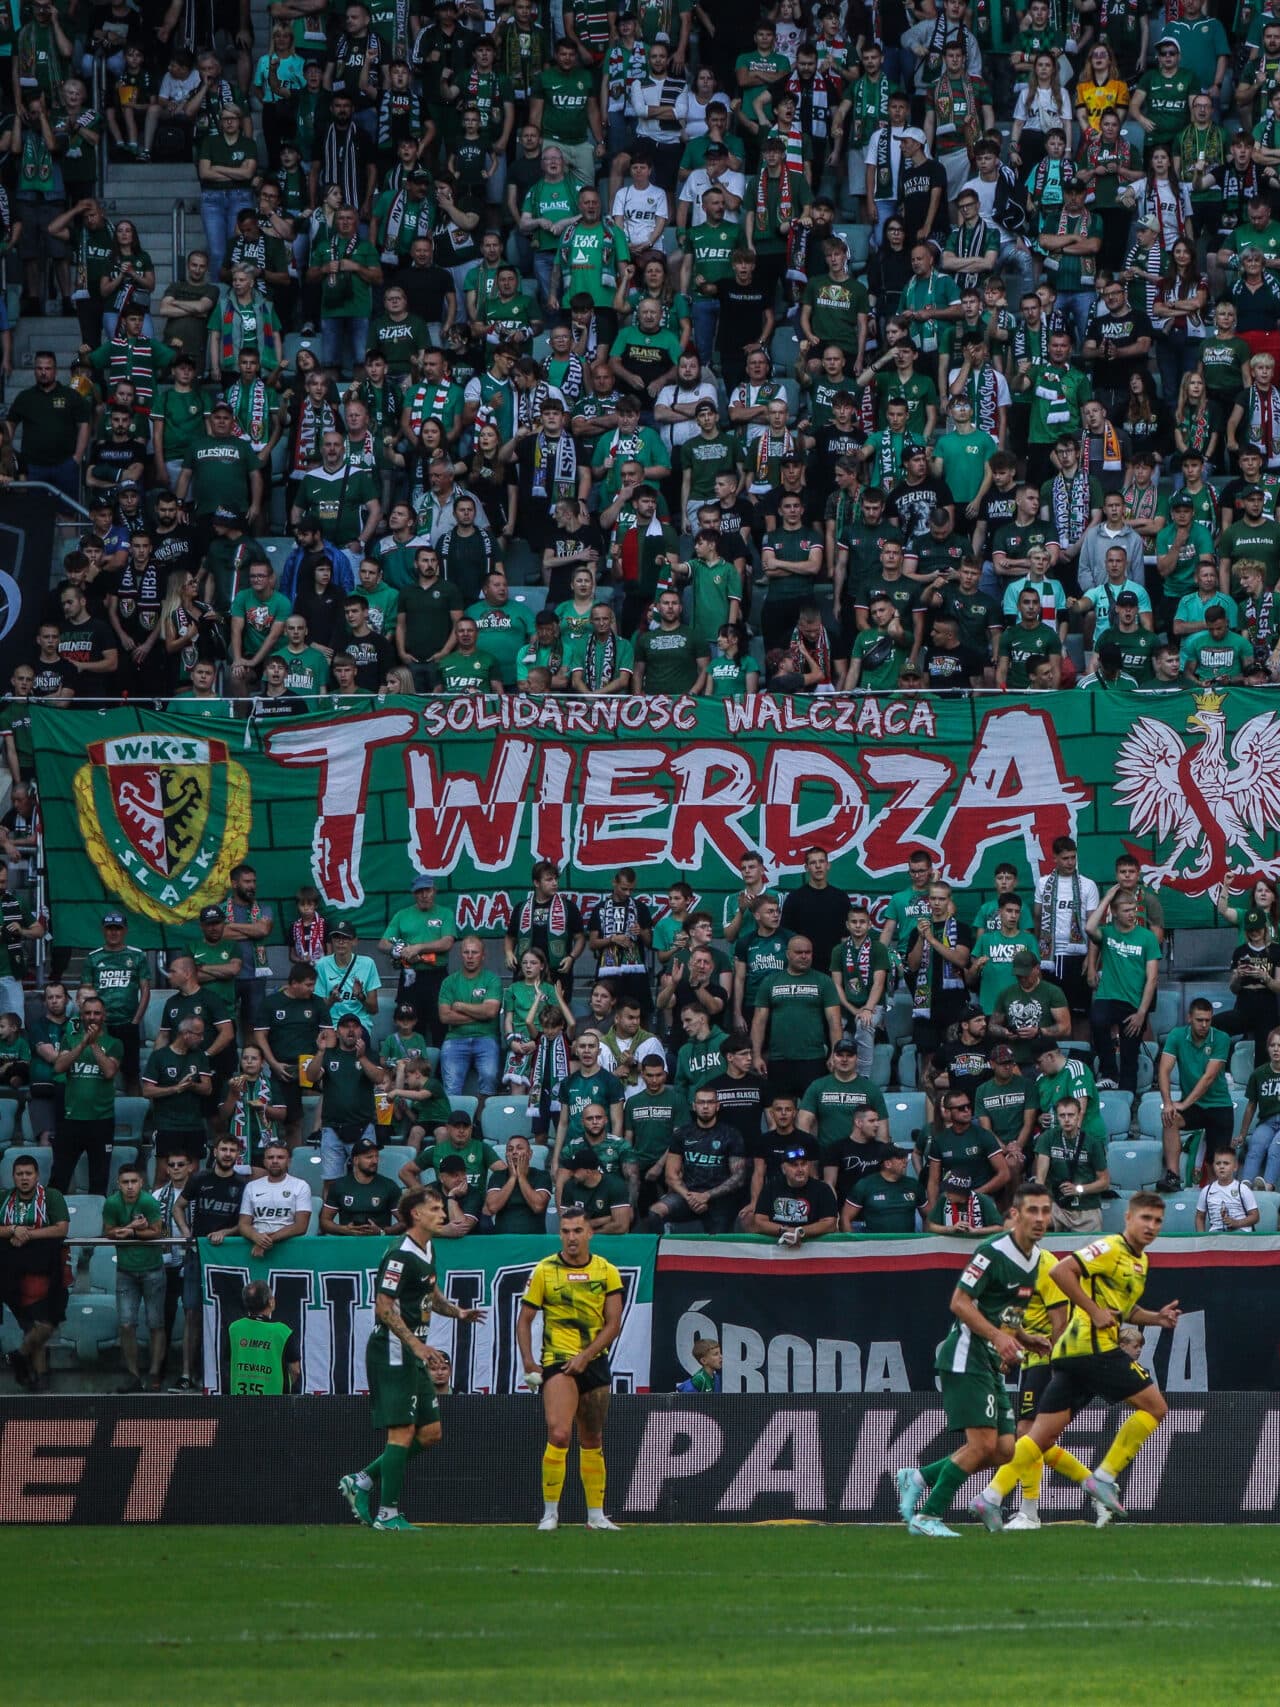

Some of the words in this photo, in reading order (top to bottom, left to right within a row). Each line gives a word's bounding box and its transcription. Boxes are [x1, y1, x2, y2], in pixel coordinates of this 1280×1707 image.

[552, 95, 588, 106] LVBET
[573, 240, 599, 249] LOKI
[197, 448, 240, 460] OLEŚNICA
[895, 491, 937, 506] TERROR
[724, 694, 938, 738] WALCZĄCA
[264, 704, 1091, 909] TWIERDZA
[456, 891, 512, 930] NA
[989, 944, 1014, 958] WKS
[99, 970, 131, 979] NOBLE
[99, 979, 130, 989] BET
[717, 1091, 735, 1100] RODA
[199, 1198, 239, 1212] LVBET
[254, 1206, 292, 1217] LVBET
[249, 1340, 272, 1350] IMPEL
[675, 1299, 911, 1393] ŚRODA
[237, 1362, 272, 1375] TEWARD
[238, 1382, 264, 1395] 355
[986, 1394, 995, 1418] 8
[622, 1410, 1205, 1511] PAKET
